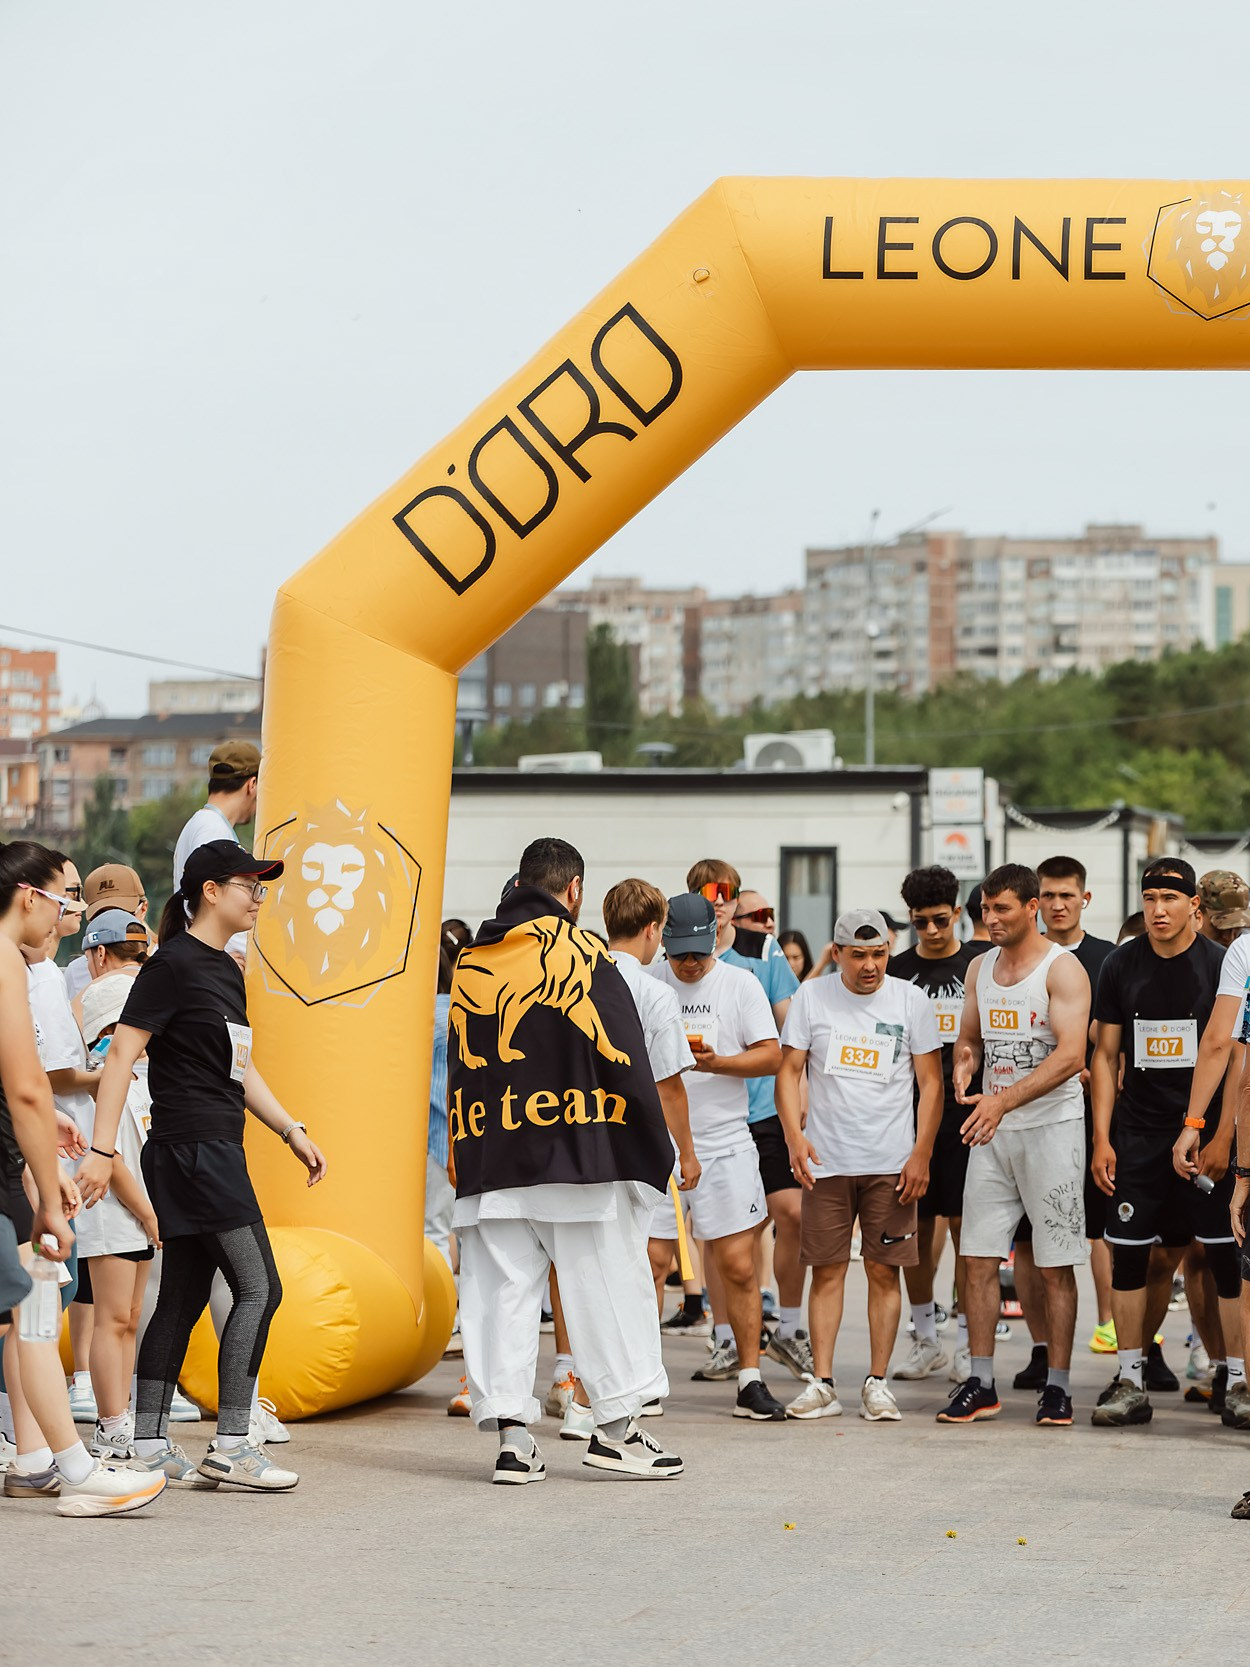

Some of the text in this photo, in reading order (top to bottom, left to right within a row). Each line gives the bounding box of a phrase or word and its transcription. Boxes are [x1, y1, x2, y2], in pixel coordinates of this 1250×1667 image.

[822, 216, 1127, 280] LEONE
[992, 1011, 1015, 1028] 501
[1149, 1039, 1179, 1055] 407
[844, 1047, 876, 1067] 334
